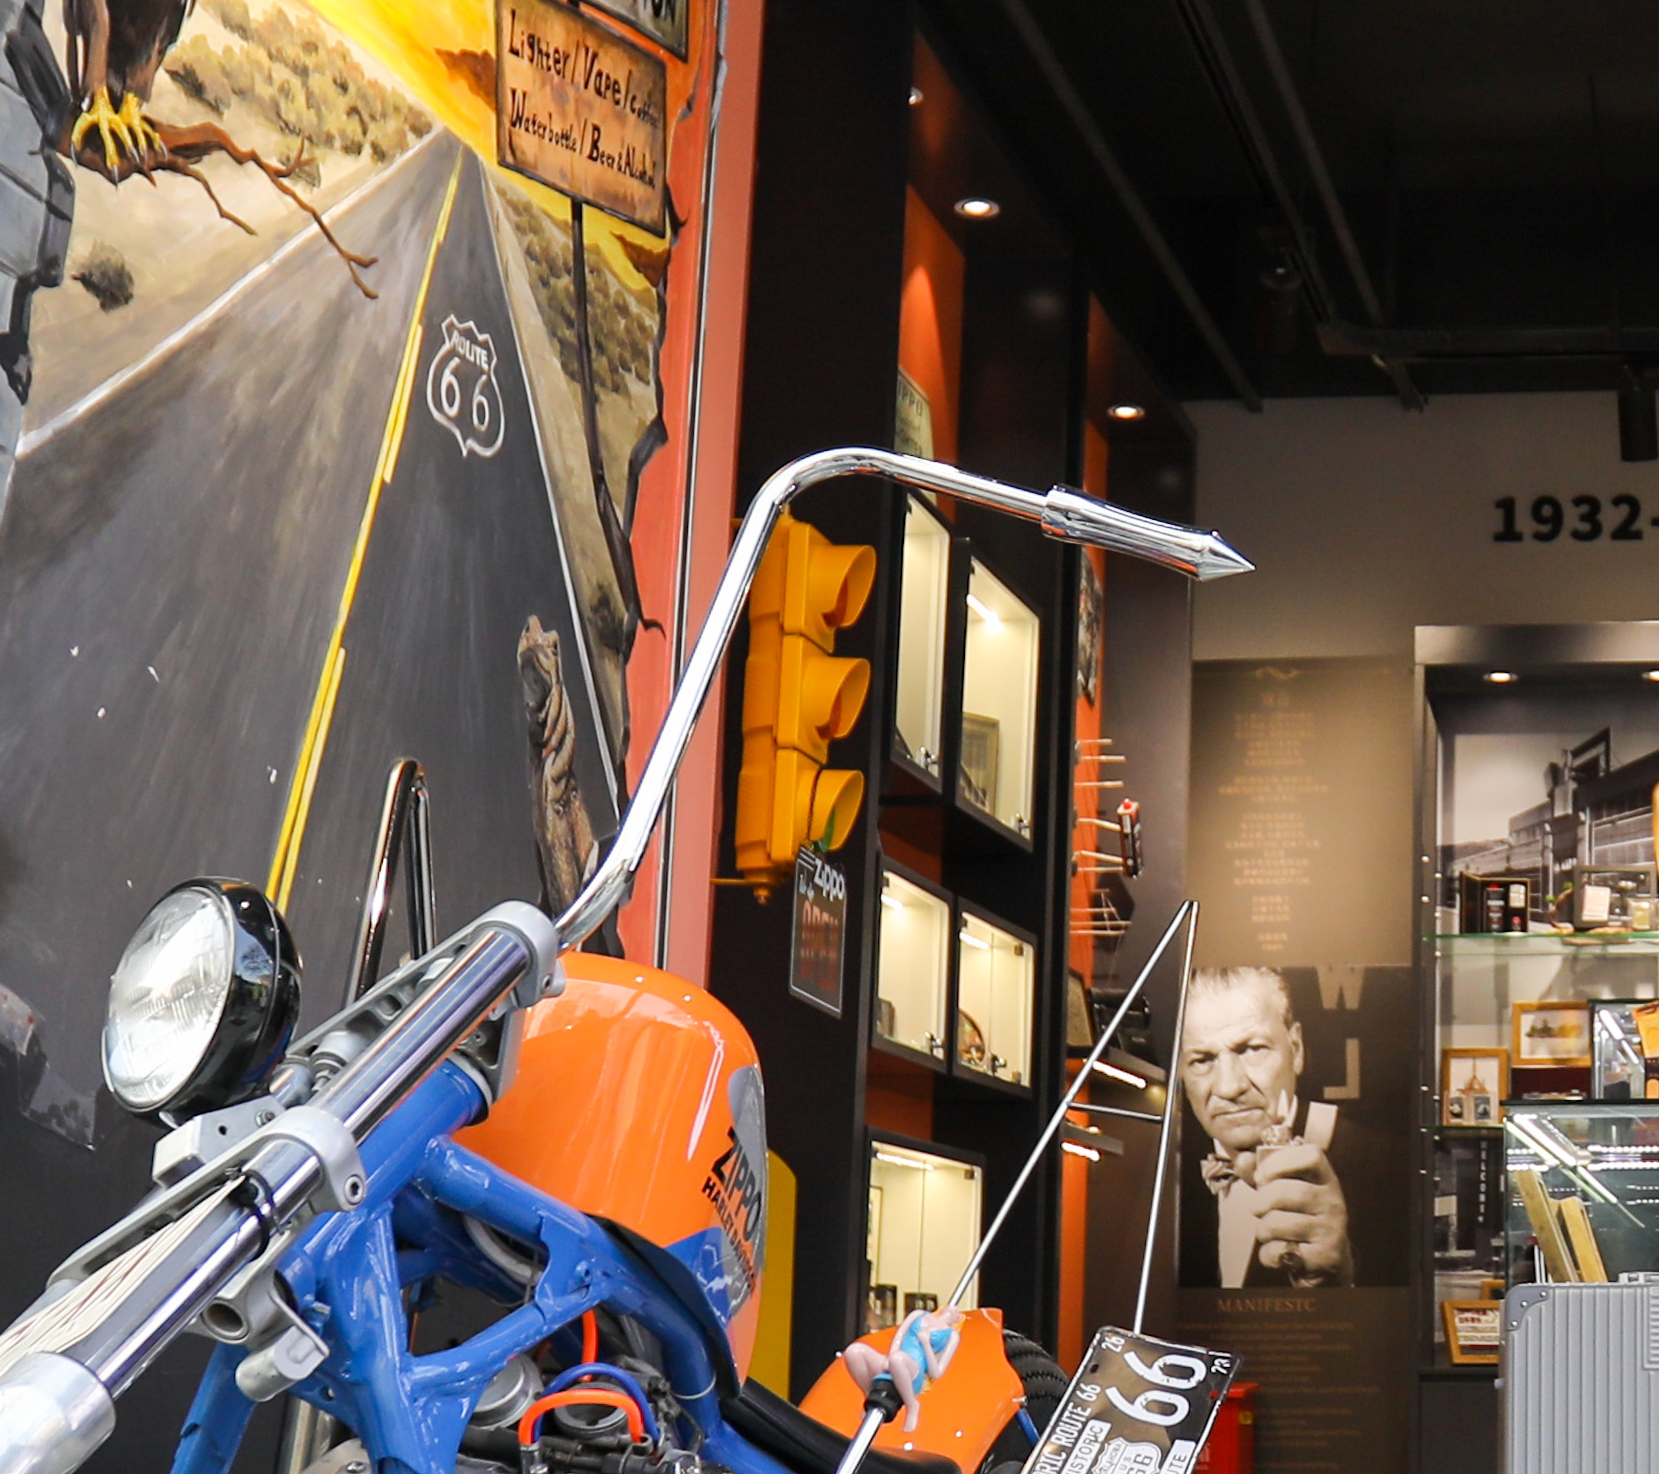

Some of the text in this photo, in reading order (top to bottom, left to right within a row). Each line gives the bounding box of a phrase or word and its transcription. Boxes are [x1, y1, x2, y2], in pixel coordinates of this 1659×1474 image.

[451, 329, 489, 371] ROUTE
[440, 356, 490, 432] 66
[711, 1125, 762, 1242] ZIPPO
[1050, 1401, 1092, 1452] ROUTE
[1075, 1382, 1102, 1403] 66
